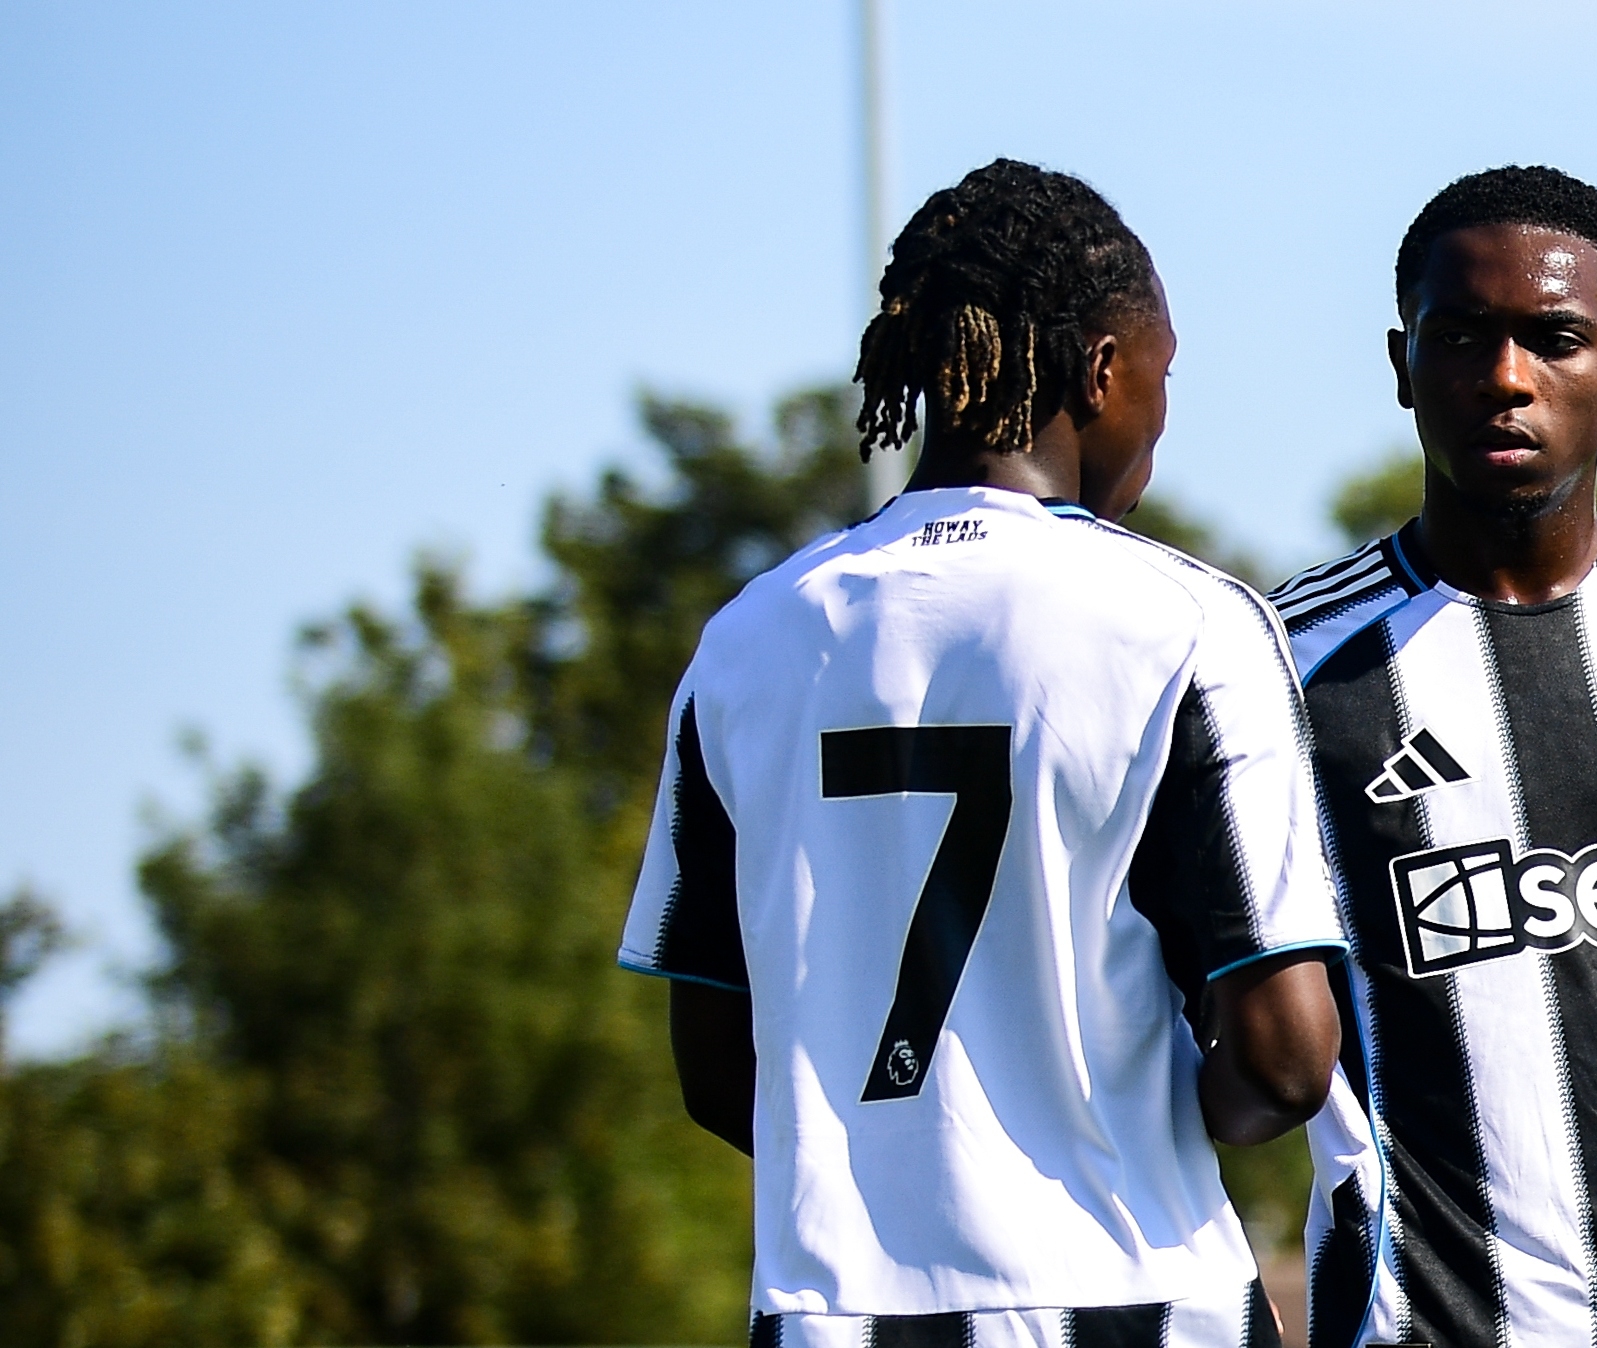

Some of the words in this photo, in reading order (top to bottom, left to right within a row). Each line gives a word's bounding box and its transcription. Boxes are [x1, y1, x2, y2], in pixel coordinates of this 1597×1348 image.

[923, 520, 983, 536] HOWAY
[912, 534, 942, 547] THE
[946, 531, 988, 544] LADS
[820, 725, 1013, 1104] 7
